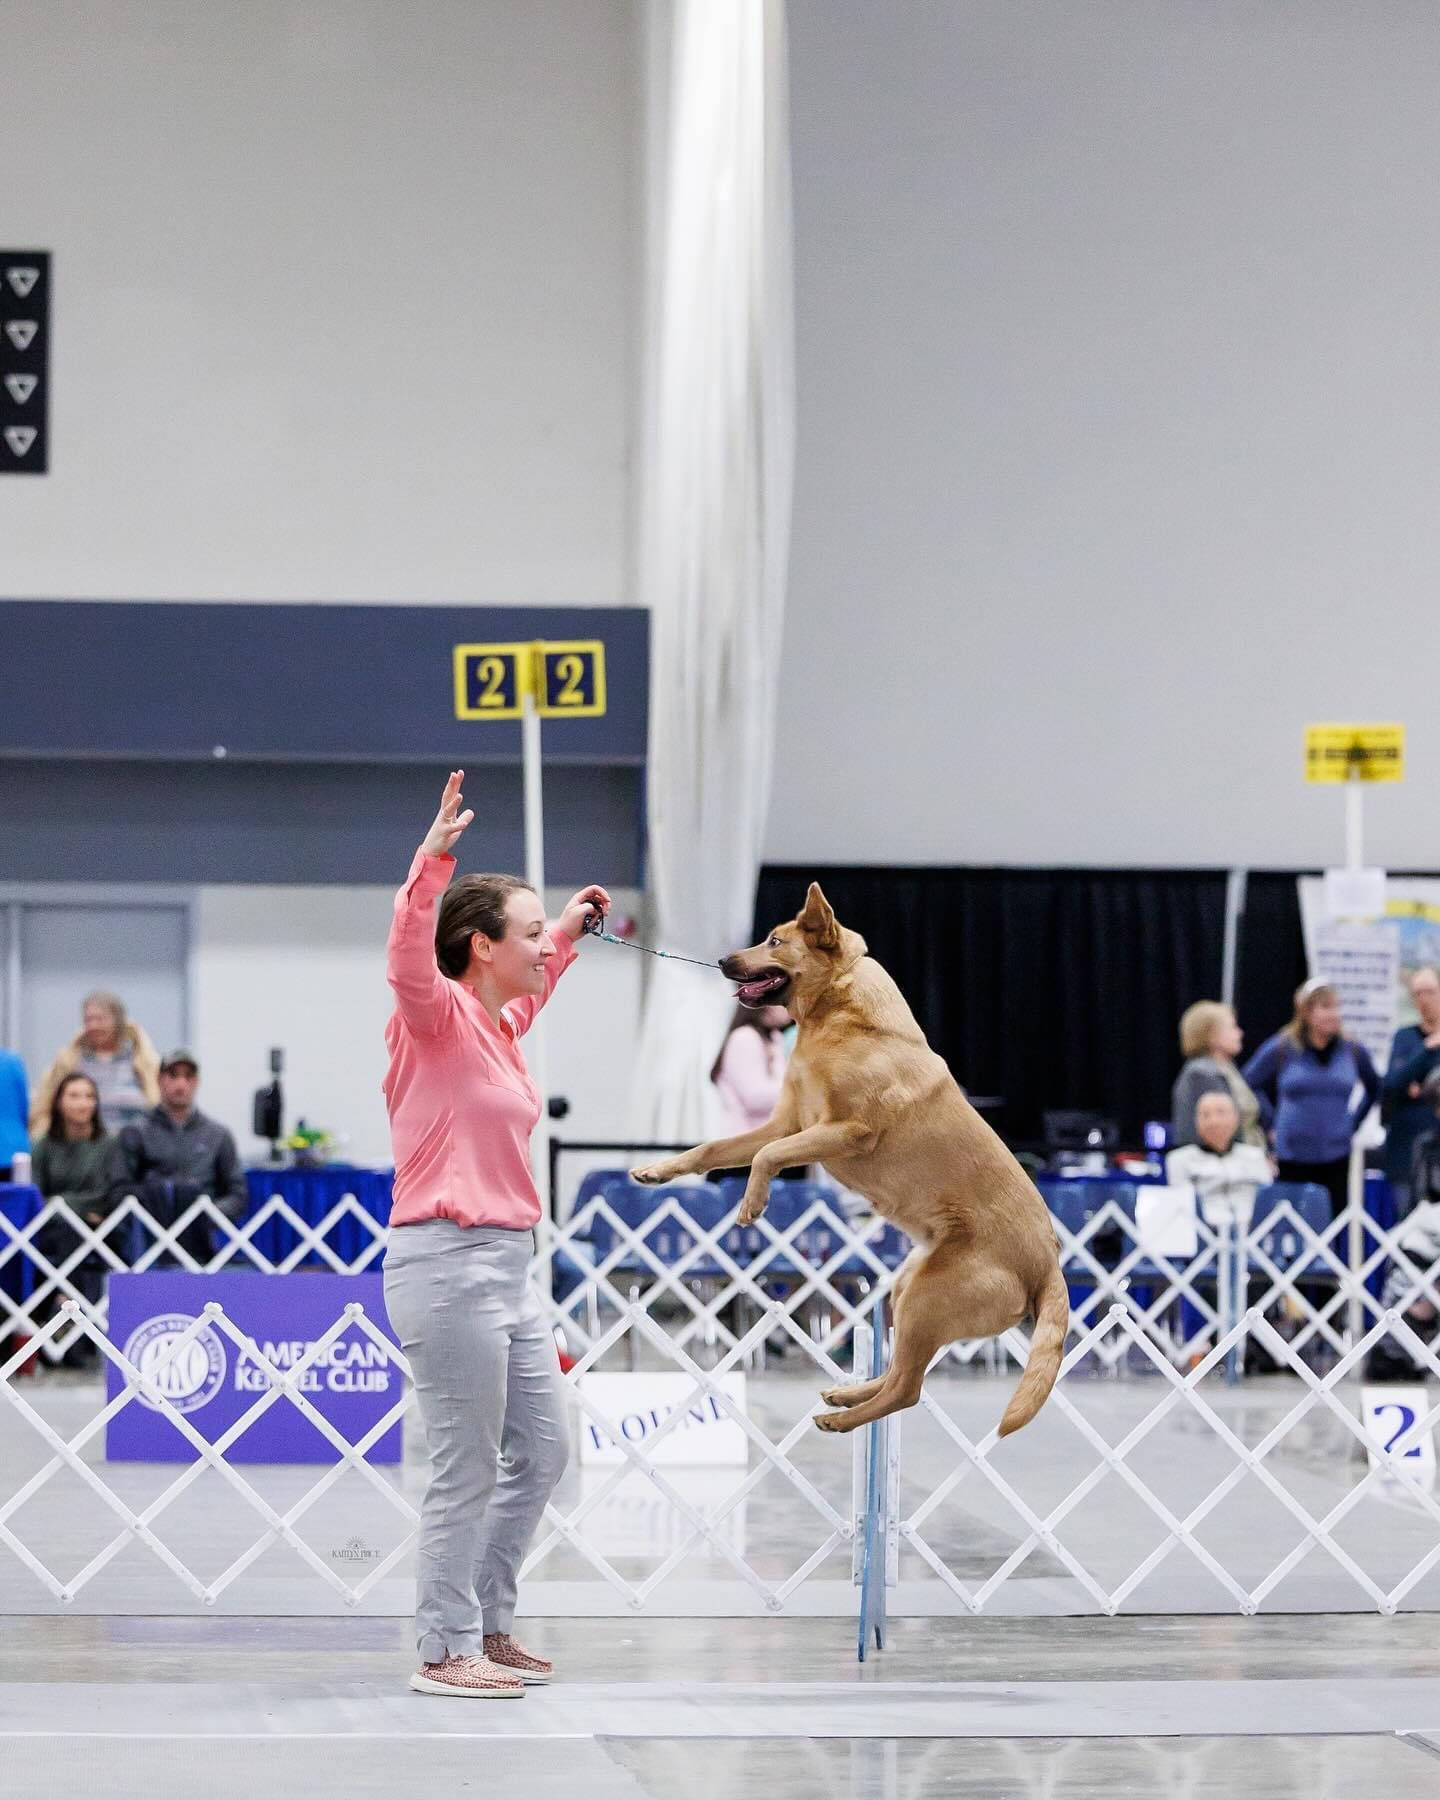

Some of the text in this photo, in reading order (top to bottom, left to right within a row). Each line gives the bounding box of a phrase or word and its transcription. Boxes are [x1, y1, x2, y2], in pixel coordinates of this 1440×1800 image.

[477, 657, 506, 707] 2
[555, 655, 584, 705] 2
[326, 1366, 389, 1392] CLUB
[1374, 1404, 1421, 1457] 2
